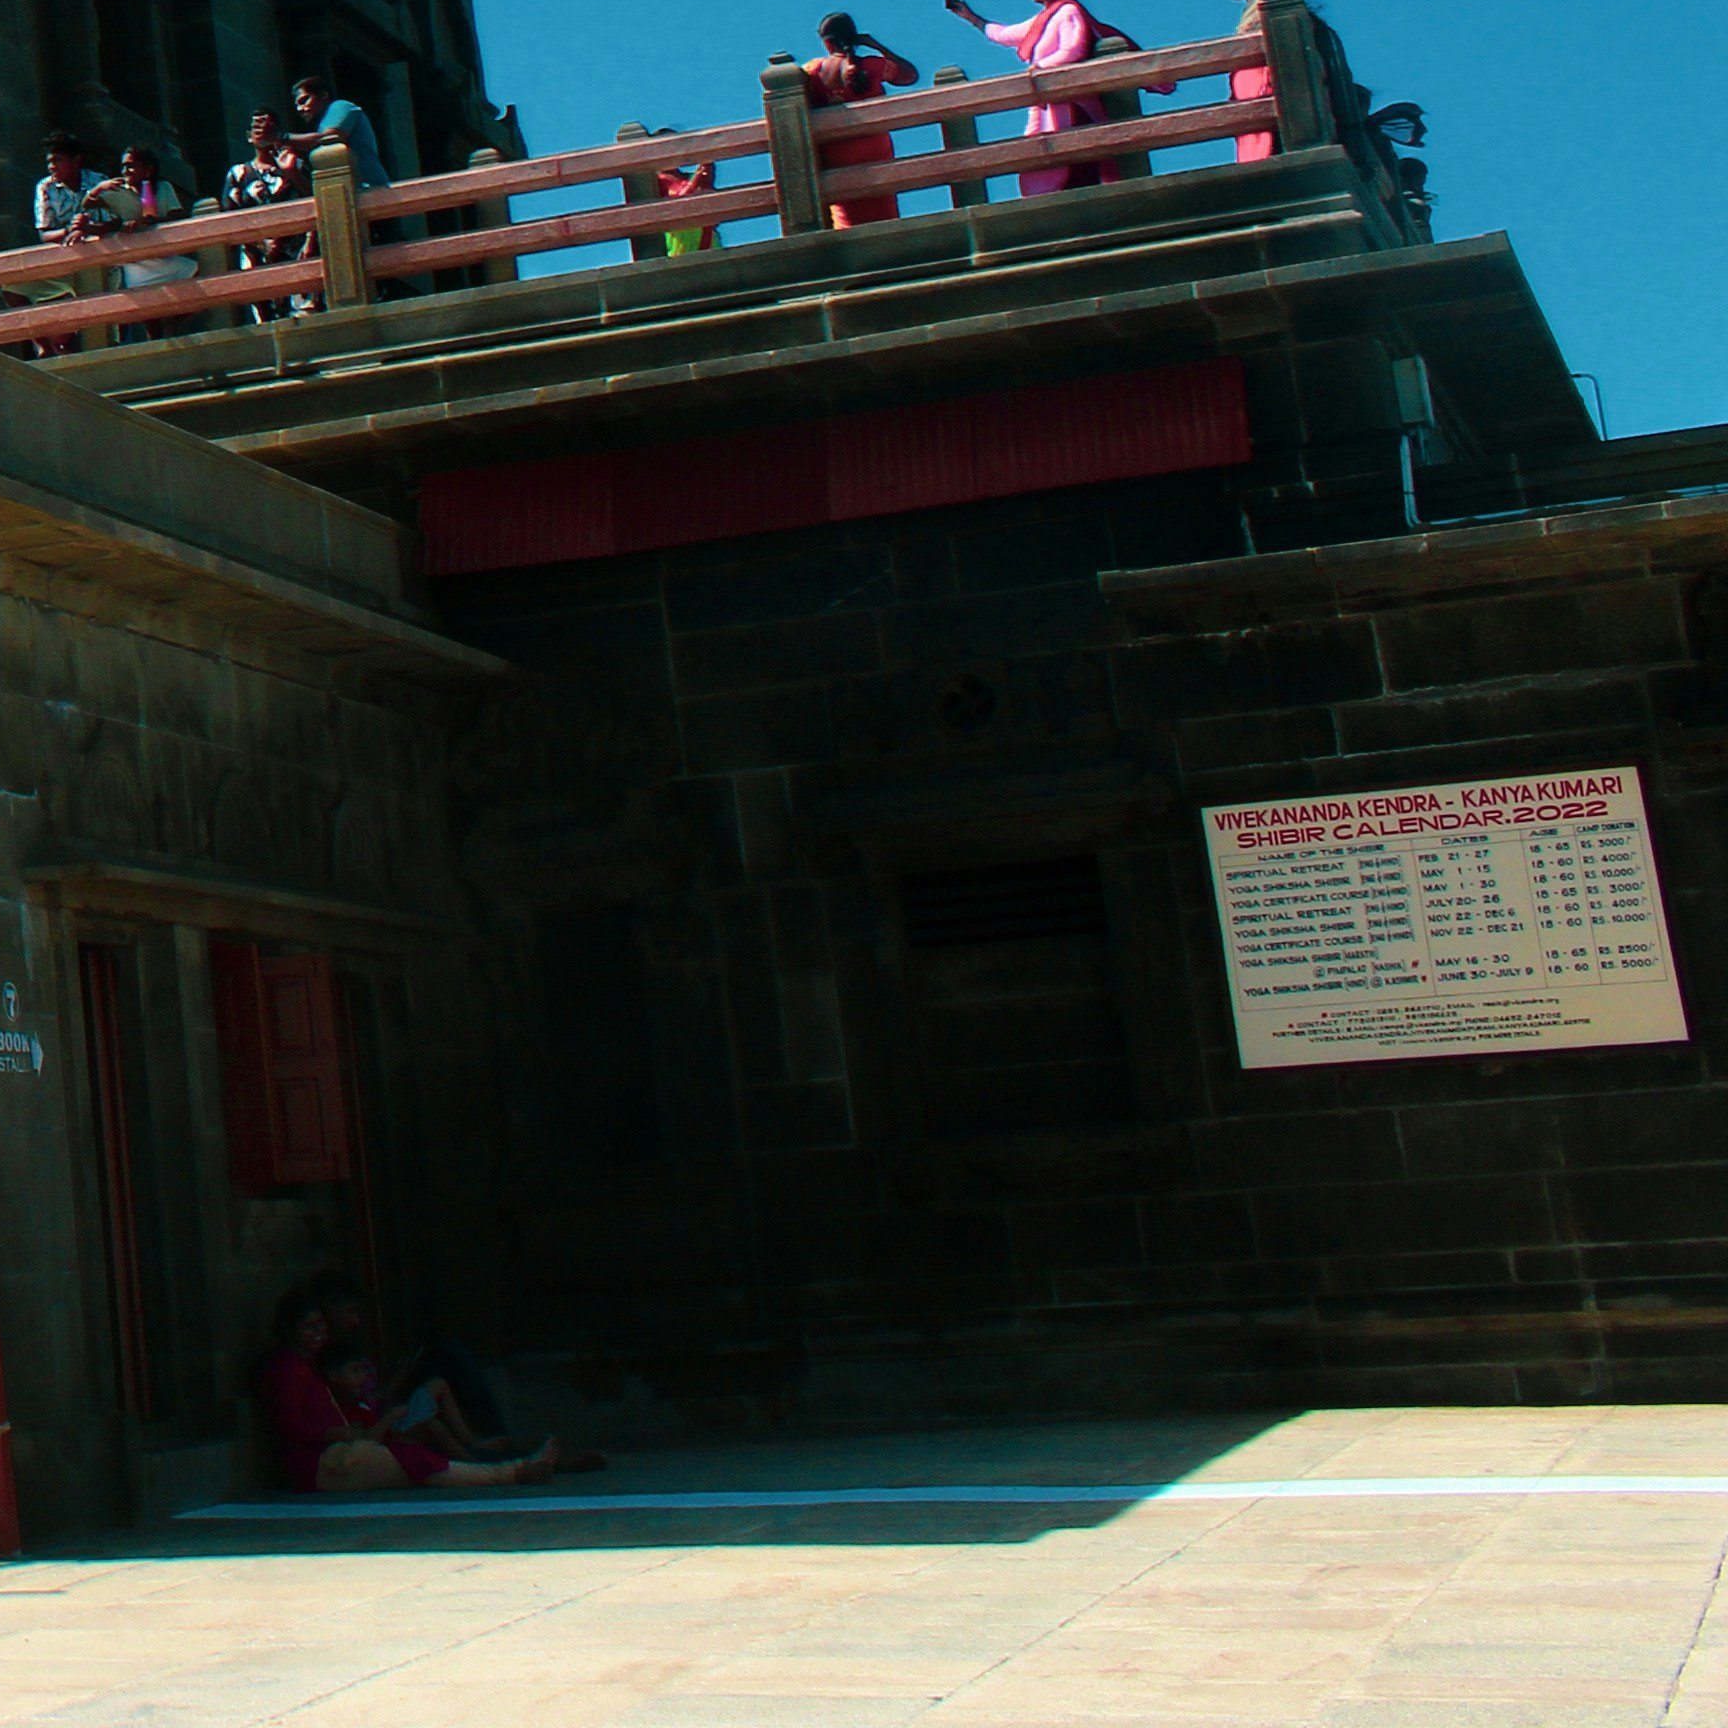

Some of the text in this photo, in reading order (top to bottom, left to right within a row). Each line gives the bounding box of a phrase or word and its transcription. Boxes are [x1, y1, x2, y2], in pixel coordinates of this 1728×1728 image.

[1214, 801, 1353, 831] VIVEKANANDA
[1357, 792, 1440, 817] KENDRA
[1236, 825, 1327, 848] SHIBIR
[1440, 834, 1489, 845] DATES
[1528, 828, 1558, 837] AGE
[1257, 844, 1384, 861] NAME OF THE SHIBIR
[1554, 842, 1569, 850] 65
[1417, 849, 1489, 863] FEB 21 27
[1531, 857, 1573, 868] 18 60
[1225, 861, 1345, 880] SPIRITUAL RETREAT
[1420, 868, 1444, 878] MAY
[1476, 864, 1491, 873] 15
[1533, 872, 1575, 883] 18 60
[1228, 876, 1350, 894] YOGA SHIKSHA SHIBIR
[1422, 883, 1447, 892] MAY
[1479, 878, 1496, 888] 30
[1230, 890, 1370, 909] YOGA CERTIFICATE COURSE
[1536, 887, 1577, 899] 18 65
[1425, 898, 1454, 908] JULY
[1537, 902, 1580, 913] 18 60
[1232, 906, 1353, 924] SPIRITUAL RETREAT
[1427, 913, 1451, 922] NOV
[1455, 911, 1471, 920] 22
[1484, 909, 1505, 918] DEC
[1430, 922, 1524, 937] NOV 22 DEC 21
[1540, 917, 1582, 928] 18 60
[1235, 921, 1356, 939] YOGA SHIKSHA SHIBIR
[1237, 935, 1363, 953] YOGA CERTIFICATE COURSE
[1239, 952, 1341, 967] YOGA SHIKSHA SHIBIR
[1434, 957, 1461, 966] MAY
[1491, 953, 1510, 963] 30
[1545, 947, 1587, 959] 18 65
[1548, 962, 1589, 973] 18 60
[1436, 971, 1467, 981] JUNE
[1469, 970, 1487, 979] 30
[1243, 981, 1343, 996] YOGA SHIKSHA SHIBIR
